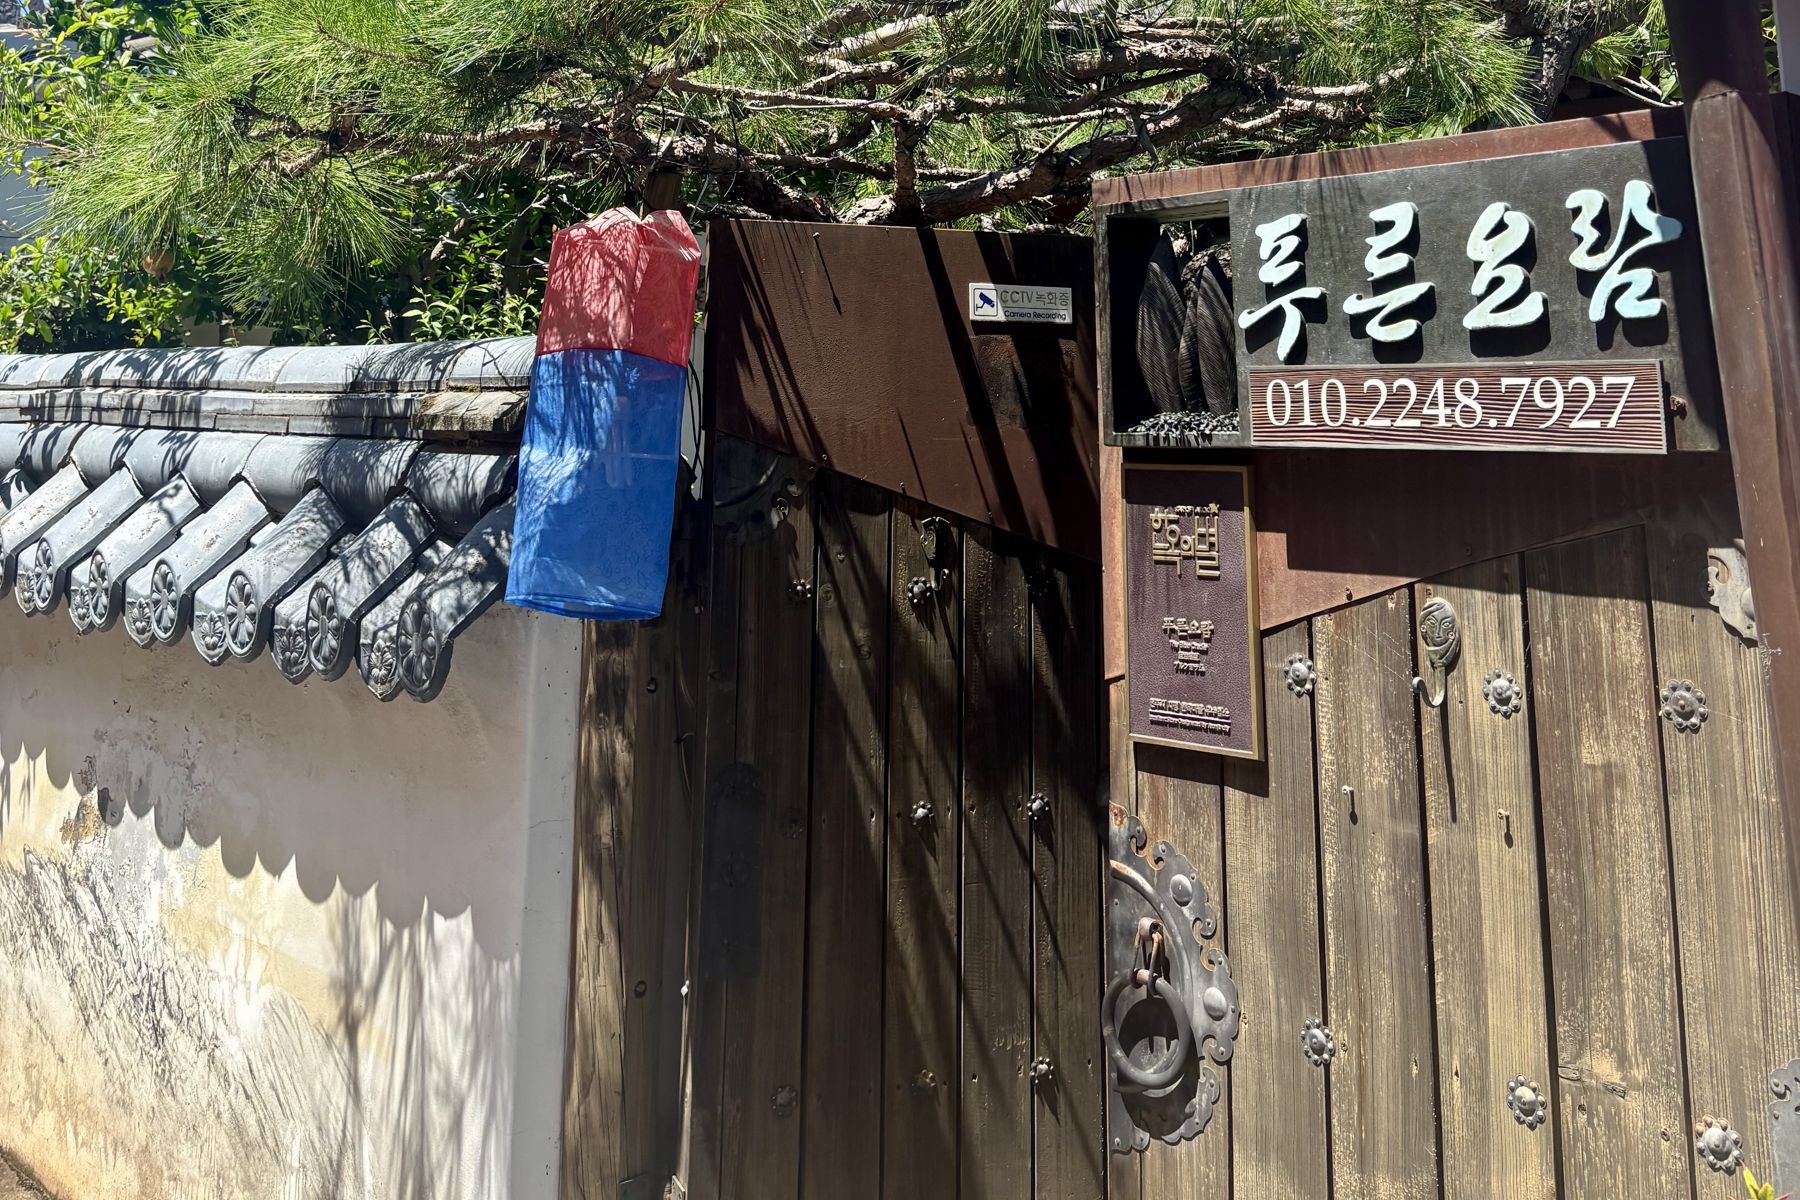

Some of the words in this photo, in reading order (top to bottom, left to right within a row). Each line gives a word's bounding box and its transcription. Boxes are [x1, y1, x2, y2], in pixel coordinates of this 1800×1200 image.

[1239, 180, 1682, 361] 푸른요람
[1000, 290, 1033, 304] CCTV
[1004, 310, 1031, 318] Camera
[1033, 311, 1066, 321] Recording
[1265, 376, 1636, 430] 010.2248.7927
[1162, 617, 1214, 638] 푸른요람
